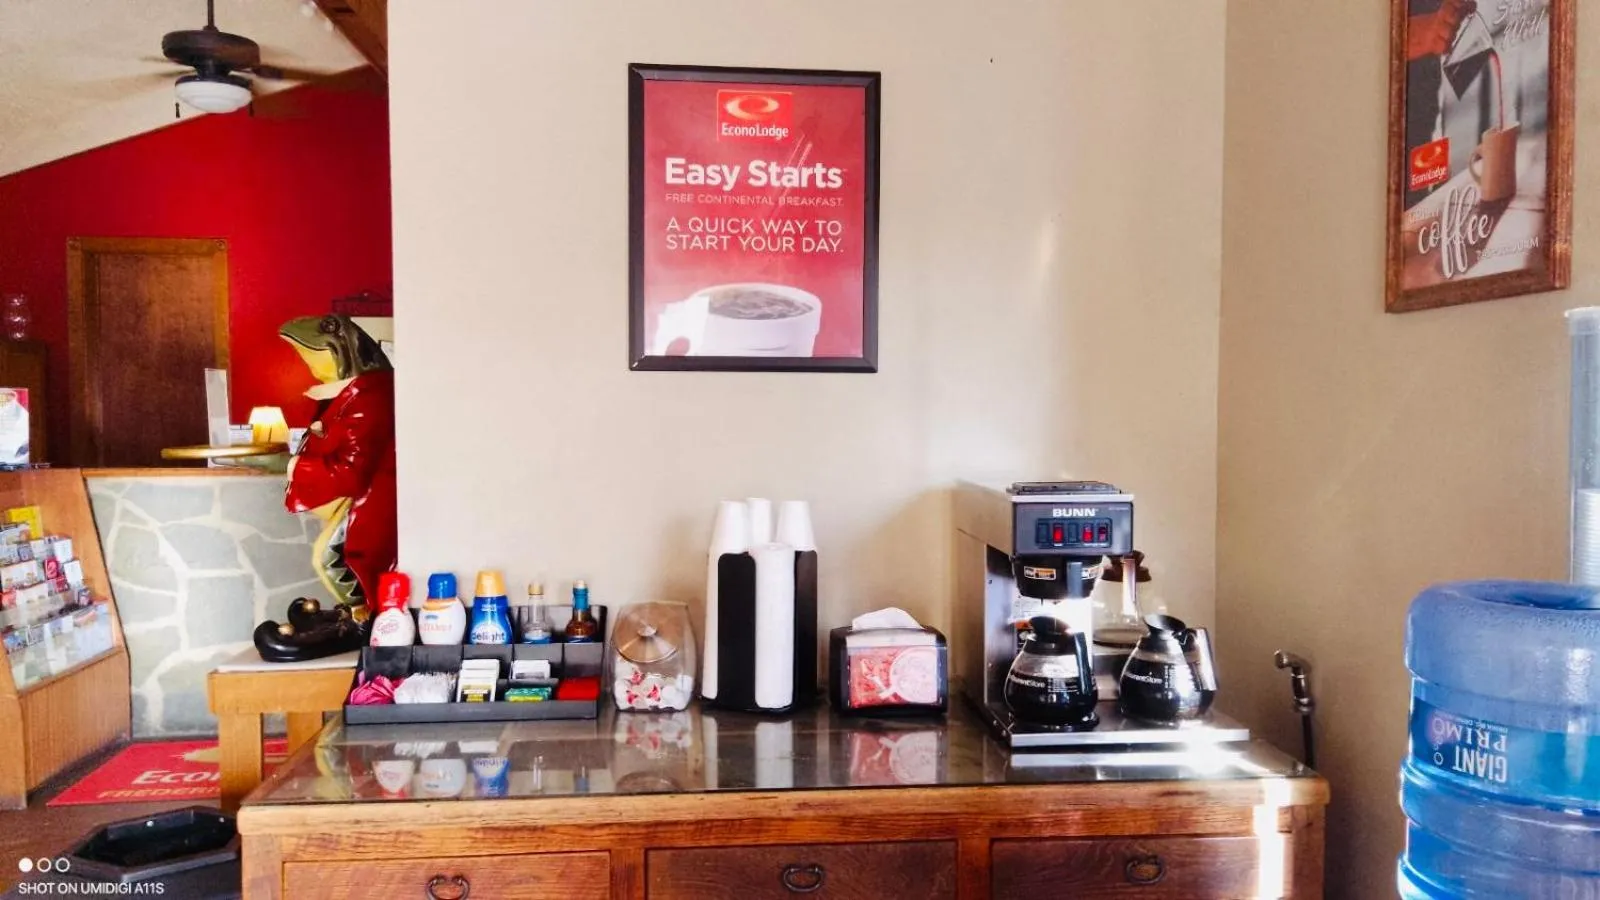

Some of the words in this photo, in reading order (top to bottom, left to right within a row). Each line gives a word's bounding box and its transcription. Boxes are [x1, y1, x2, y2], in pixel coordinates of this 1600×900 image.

[721, 123, 789, 141] EconoLodge
[665, 158, 741, 191] Easy
[748, 160, 843, 188] Starts
[665, 193, 694, 204] FREE
[698, 194, 775, 206] CONTINENTAL
[666, 216, 680, 232] A
[688, 217, 755, 235] QUICK
[761, 220, 808, 235] WAY
[815, 220, 842, 236] TO
[1418, 185, 1493, 278] coffee
[666, 235, 731, 250] START
[738, 236, 794, 252] YOUR
[802, 237, 844, 253] DAY.
[1052, 507, 1096, 517] BUNN
[1433, 718, 1507, 752] PRIMO
[1453, 746, 1508, 784] GIANT
